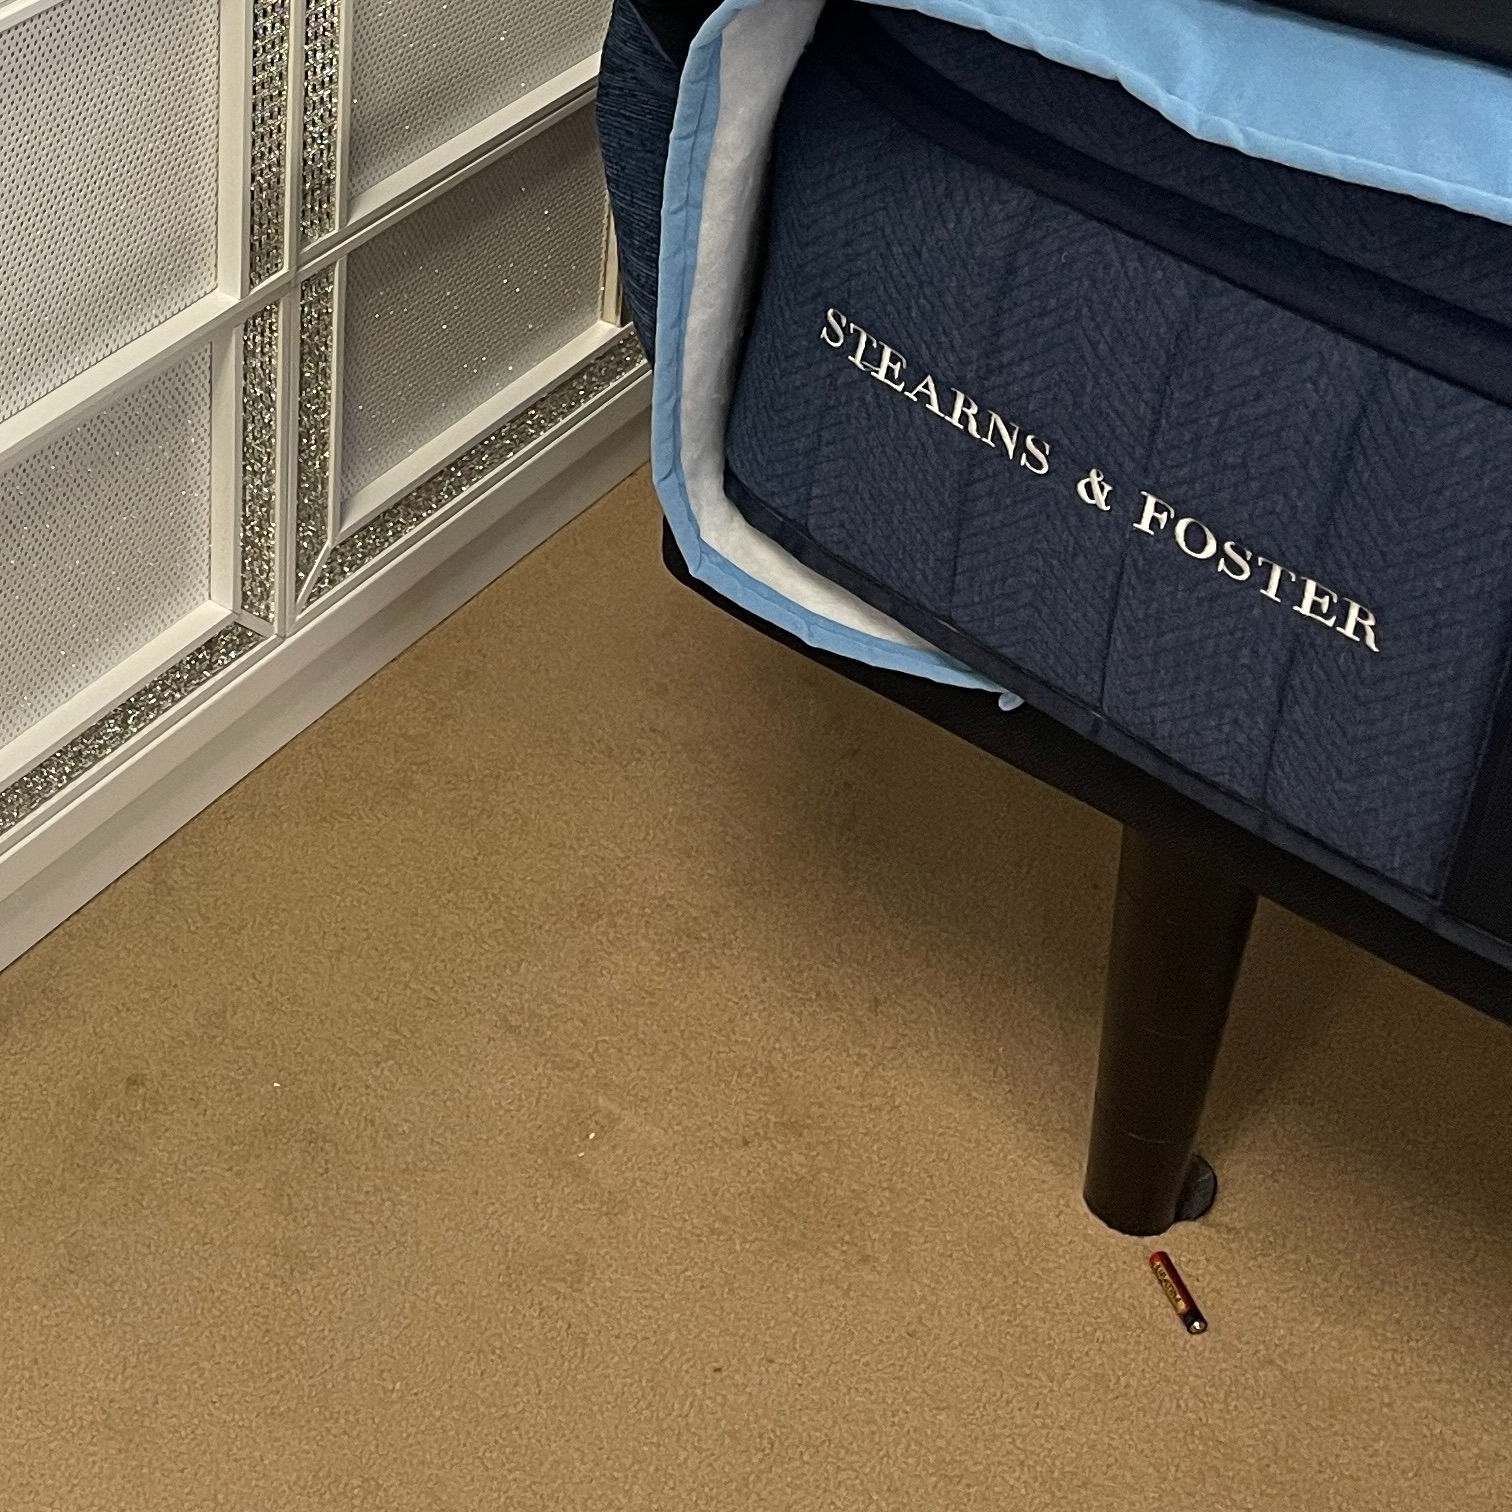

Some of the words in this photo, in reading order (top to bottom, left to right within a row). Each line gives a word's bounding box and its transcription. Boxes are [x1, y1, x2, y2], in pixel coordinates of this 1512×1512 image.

[820, 308, 1051, 475] STEARNS
[1076, 468, 1113, 511] &
[1133, 491, 1380, 653] FOSTER
